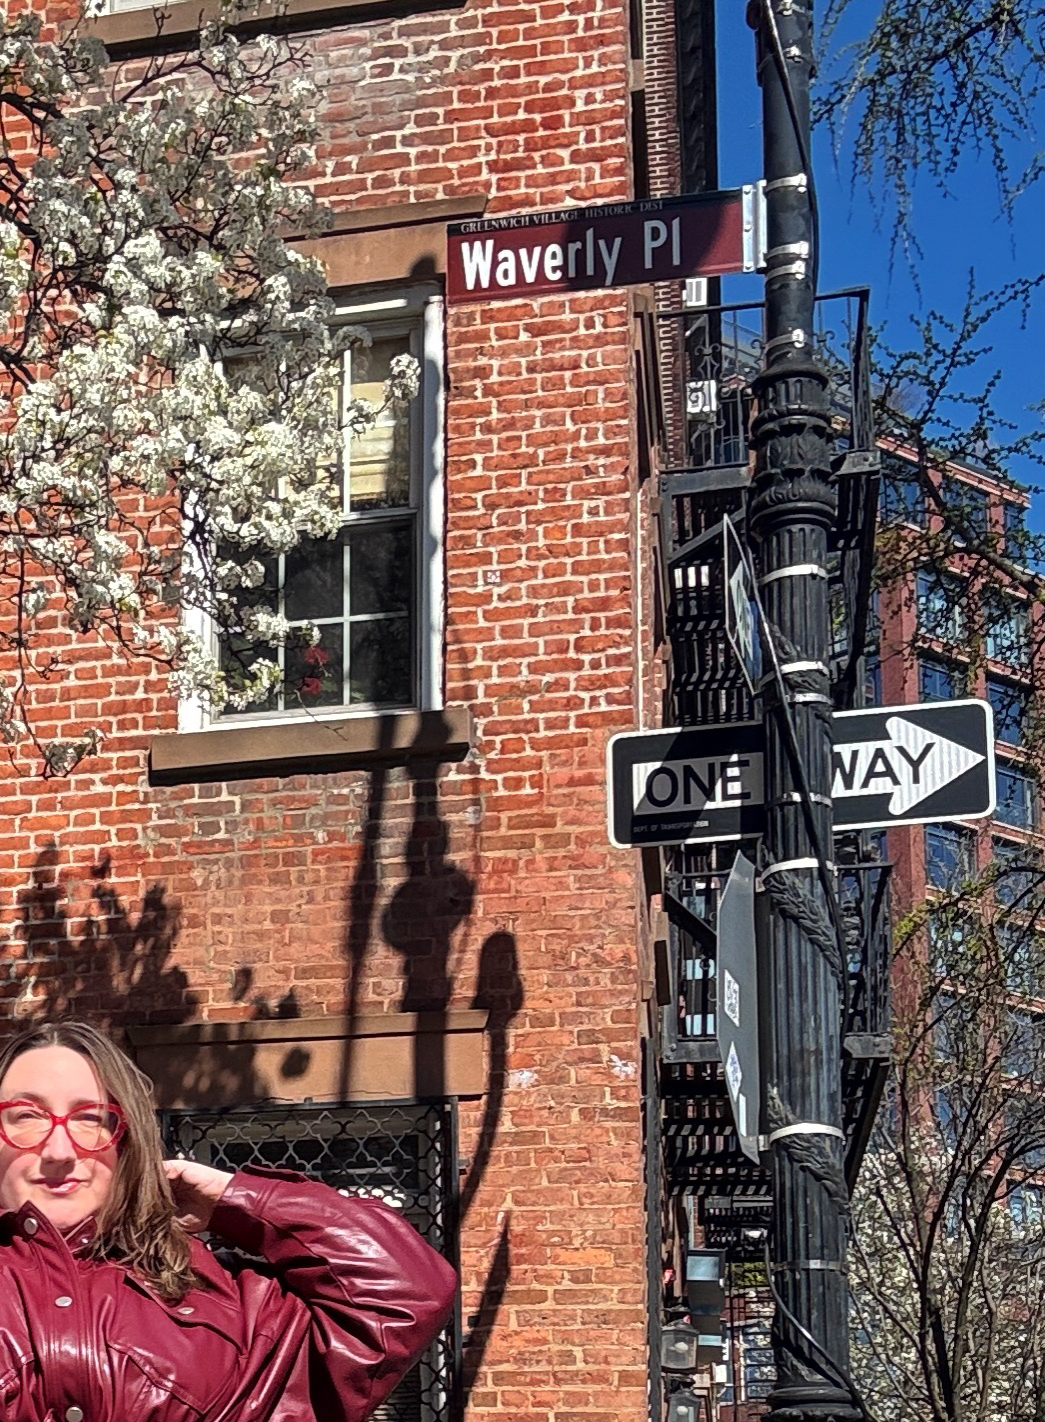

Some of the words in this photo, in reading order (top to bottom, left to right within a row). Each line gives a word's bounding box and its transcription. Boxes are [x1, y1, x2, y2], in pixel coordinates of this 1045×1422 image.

[460, 215, 530, 233] GREENWICH
[533, 209, 579, 225] VILLAGE
[585, 203, 633, 219] HISTORIC
[640, 200, 664, 212] DIST
[461, 227, 622, 290] Waverly
[644, 216, 681, 270] Pl
[646, 759, 751, 808] ONE
[832, 742, 936, 791] WAY
